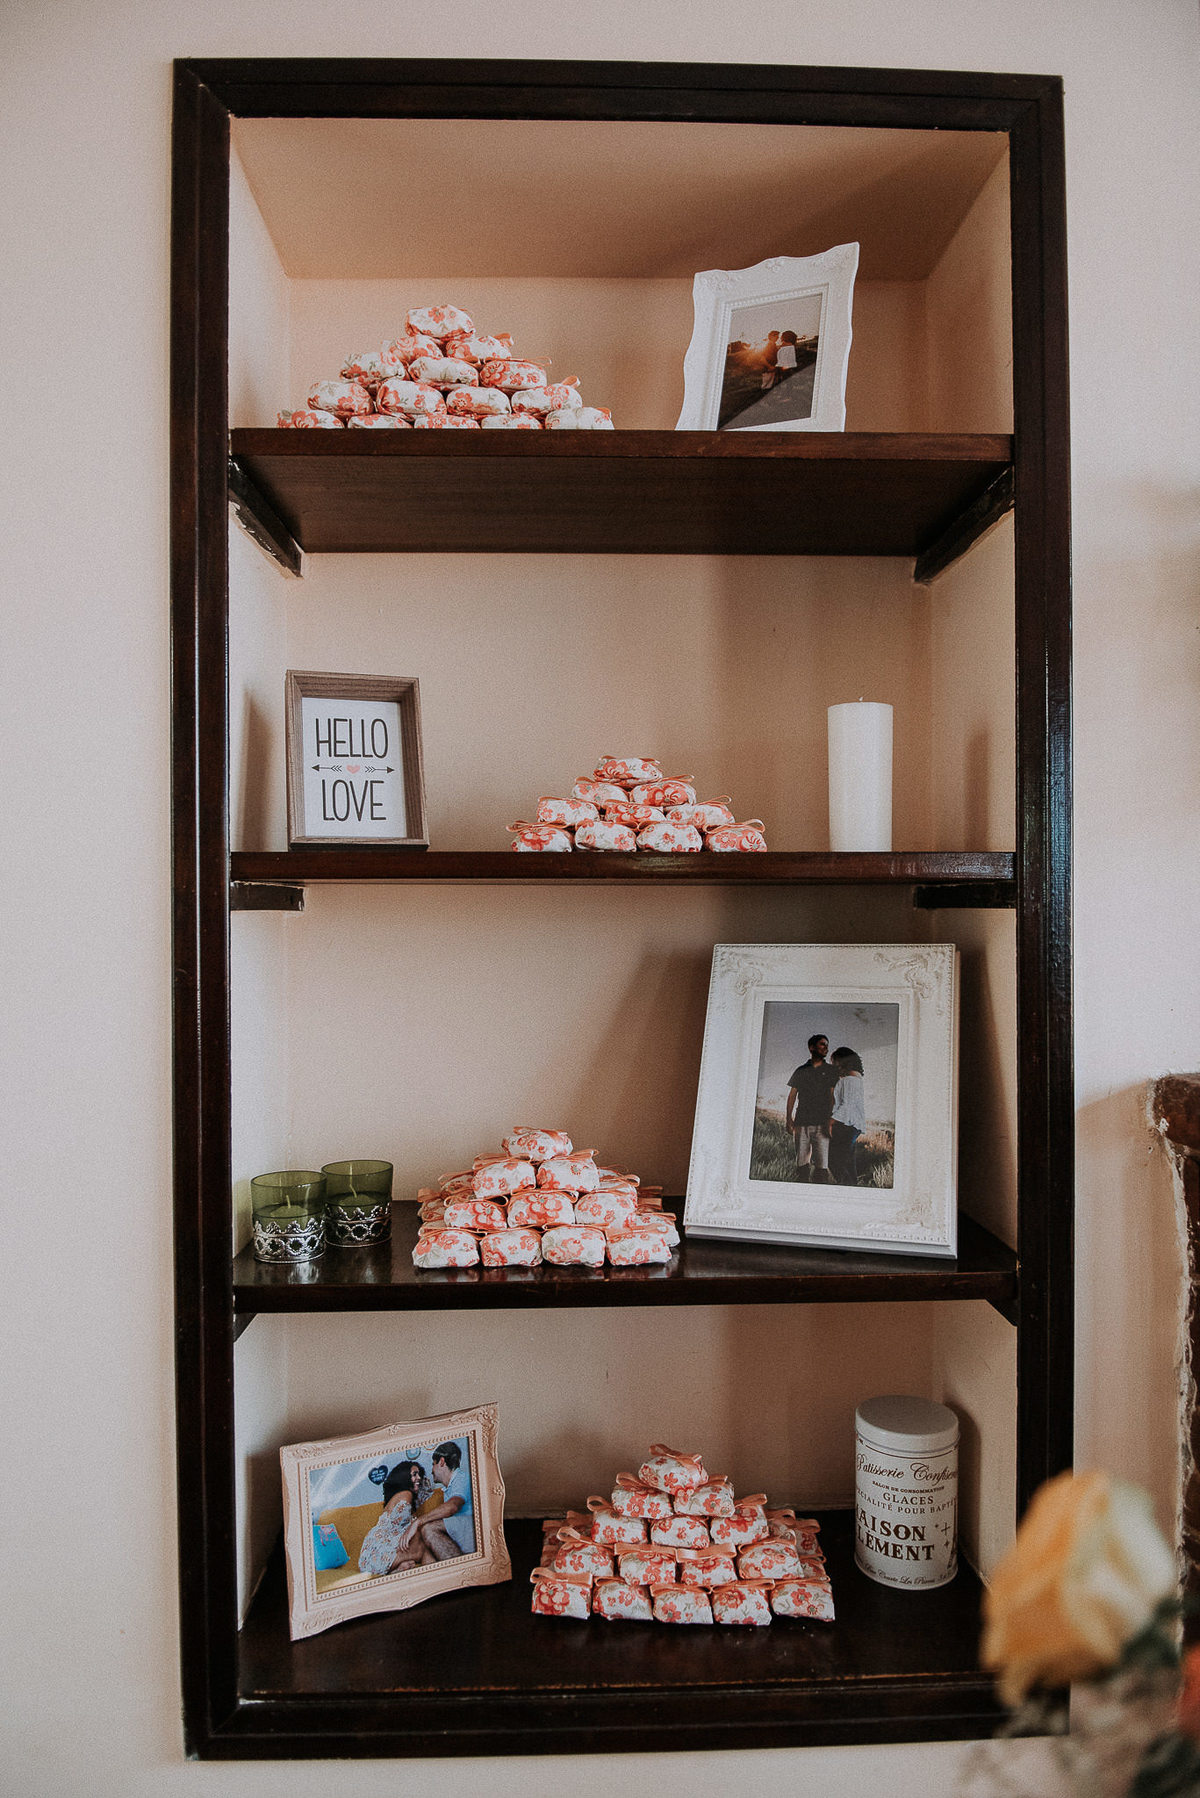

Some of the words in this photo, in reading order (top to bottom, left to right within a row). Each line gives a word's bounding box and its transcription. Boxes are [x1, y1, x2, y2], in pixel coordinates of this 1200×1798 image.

[315, 718, 389, 759] HELLO
[321, 779, 387, 822] LOVE
[872, 1480, 890, 1491] SALON
[900, 1485, 945, 1494] CONSOMMATION
[883, 1492, 934, 1506] GLACES
[897, 1506, 926, 1515] POUR
